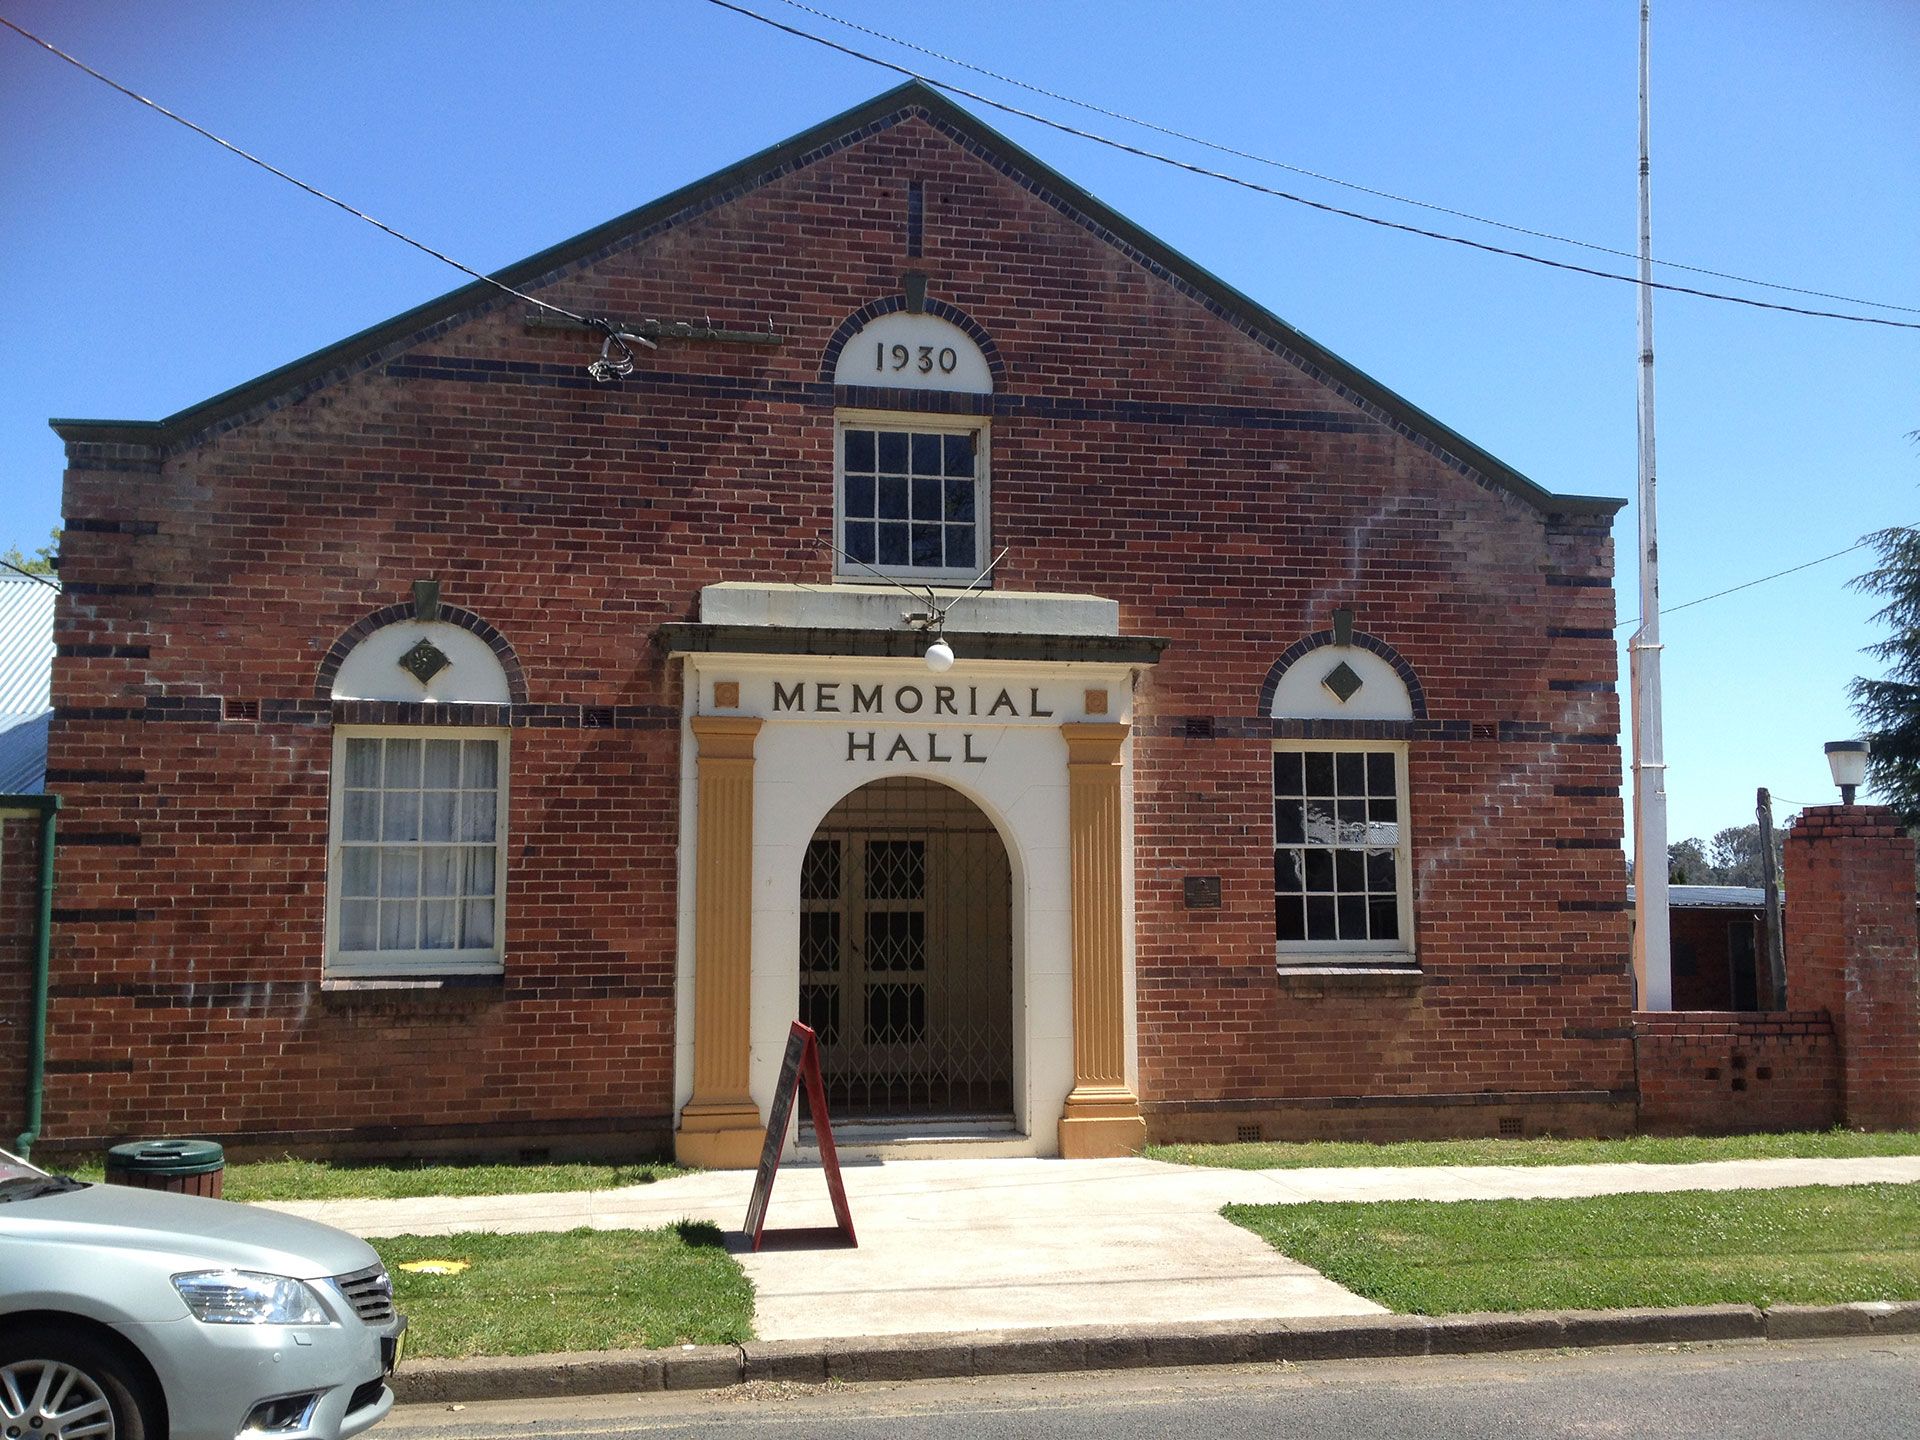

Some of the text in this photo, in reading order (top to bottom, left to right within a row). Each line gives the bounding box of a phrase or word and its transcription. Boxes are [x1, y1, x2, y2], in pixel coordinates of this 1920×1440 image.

[876, 342, 957, 374] 1930
[772, 681, 1054, 717] MEMORIAL
[846, 731, 988, 763] HALL
